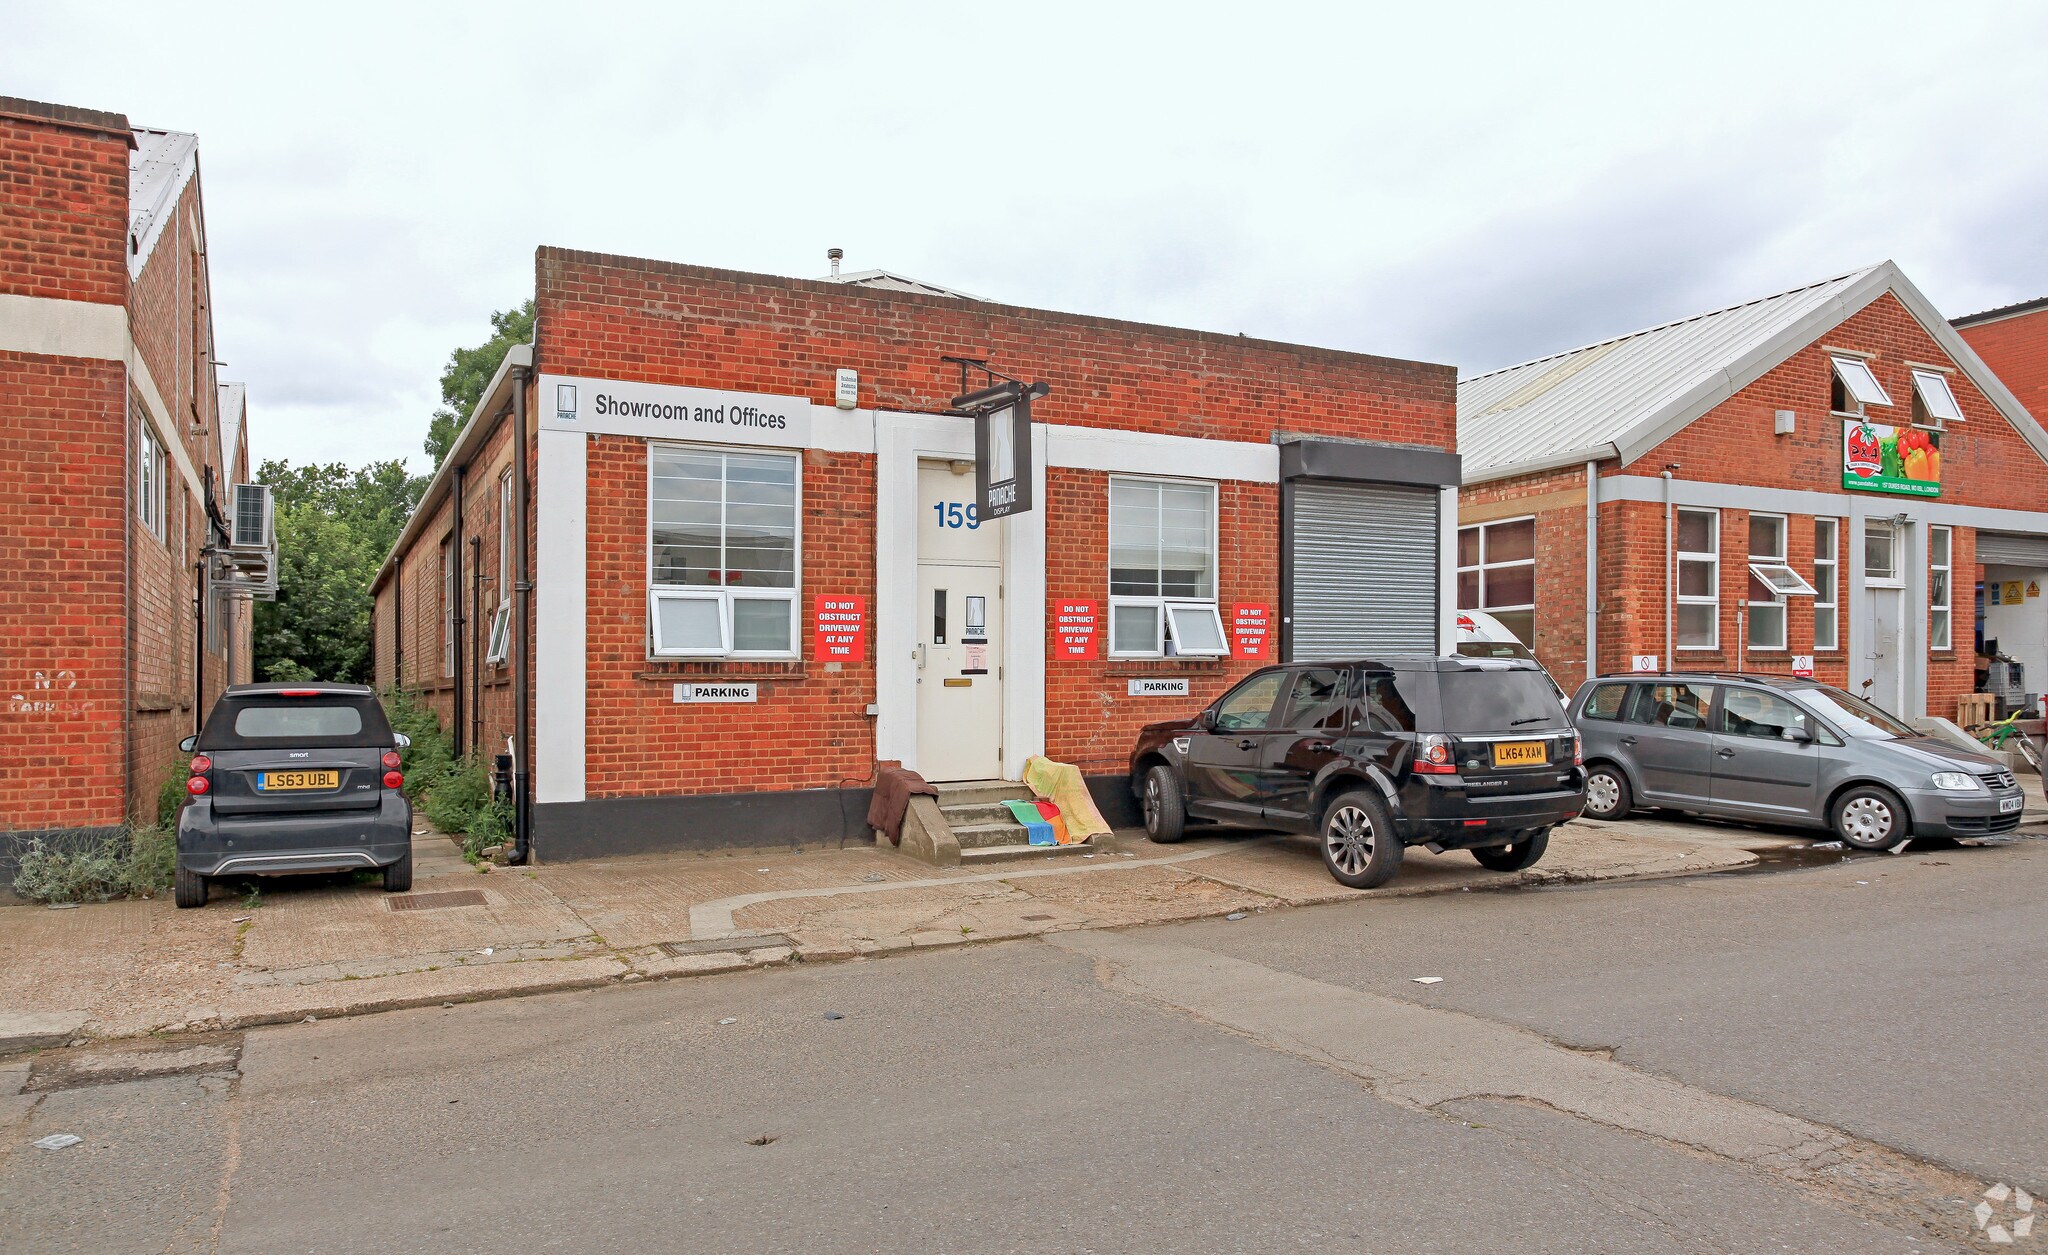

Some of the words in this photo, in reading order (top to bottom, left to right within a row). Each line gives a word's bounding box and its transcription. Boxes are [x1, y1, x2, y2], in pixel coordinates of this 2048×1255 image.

[595, 394, 688, 421] Showroom
[694, 404, 724, 424] and
[729, 405, 786, 430] Offices
[993, 505, 1011, 516] DISPLAY
[933, 501, 981, 530] 159
[825, 602, 837, 610] DO
[838, 602, 855, 610] NOT
[1063, 605, 1074, 613] DO
[819, 613, 861, 621] OBSTRUCT
[819, 624, 861, 632] DRIVEWAY
[1074, 636, 1089, 644] ANY
[1068, 646, 1085, 654] TIME
[1144, 682, 1184, 691] PARKING
[695, 688, 750, 697] PARKING
[1499, 747, 1523, 760] LK64
[267, 774, 304, 787] LS63
[308, 773, 335, 785] UBL
